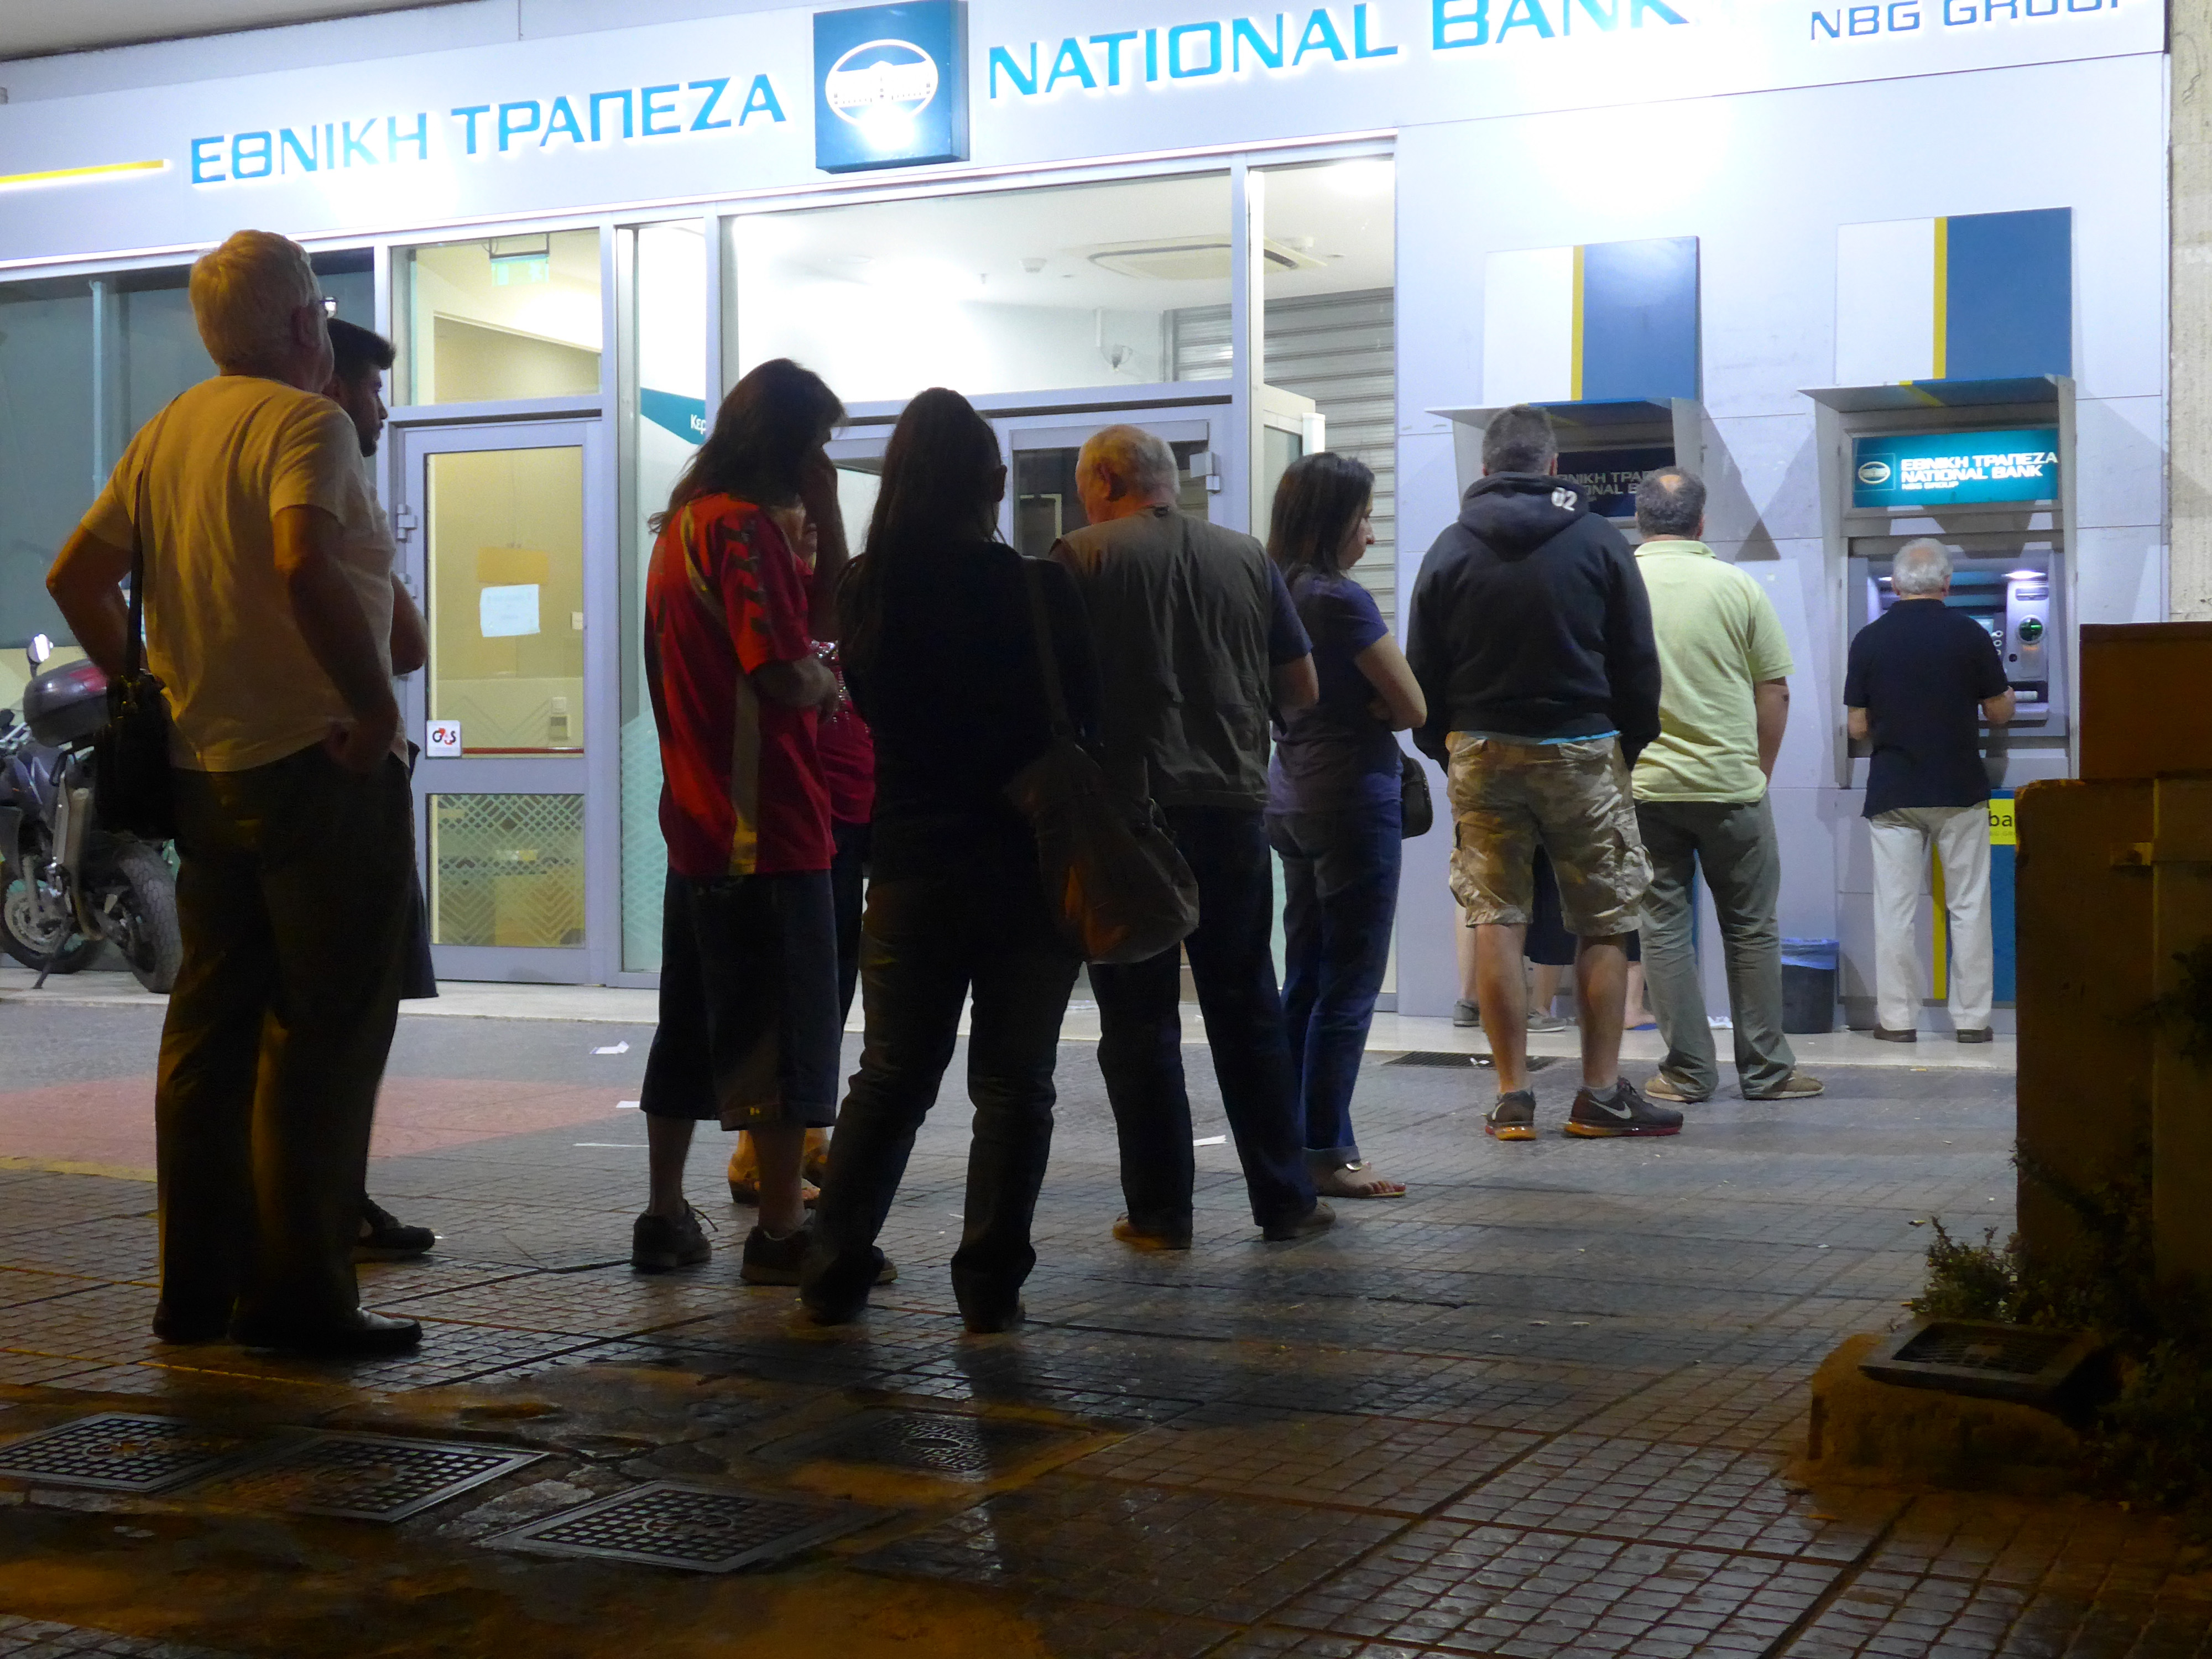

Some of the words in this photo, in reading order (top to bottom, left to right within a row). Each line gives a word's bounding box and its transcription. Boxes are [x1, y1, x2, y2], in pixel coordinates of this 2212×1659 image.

[1811, 1, 1920, 40] NBG
[989, 3, 1398, 99] NATIONAL
[191, 112, 427, 184] ΕΘΝΙΚΗ
[451, 74, 786, 155] ΤΡΑΠΕΖΑ
[1901, 456, 1969, 471] ΕΘΝΙΚΗ
[1972, 452, 2058, 467] ΤΡΑΠΕΖΑ
[1901, 468, 1988, 483] NATIONAL
[1992, 465, 2043, 479] BANK
